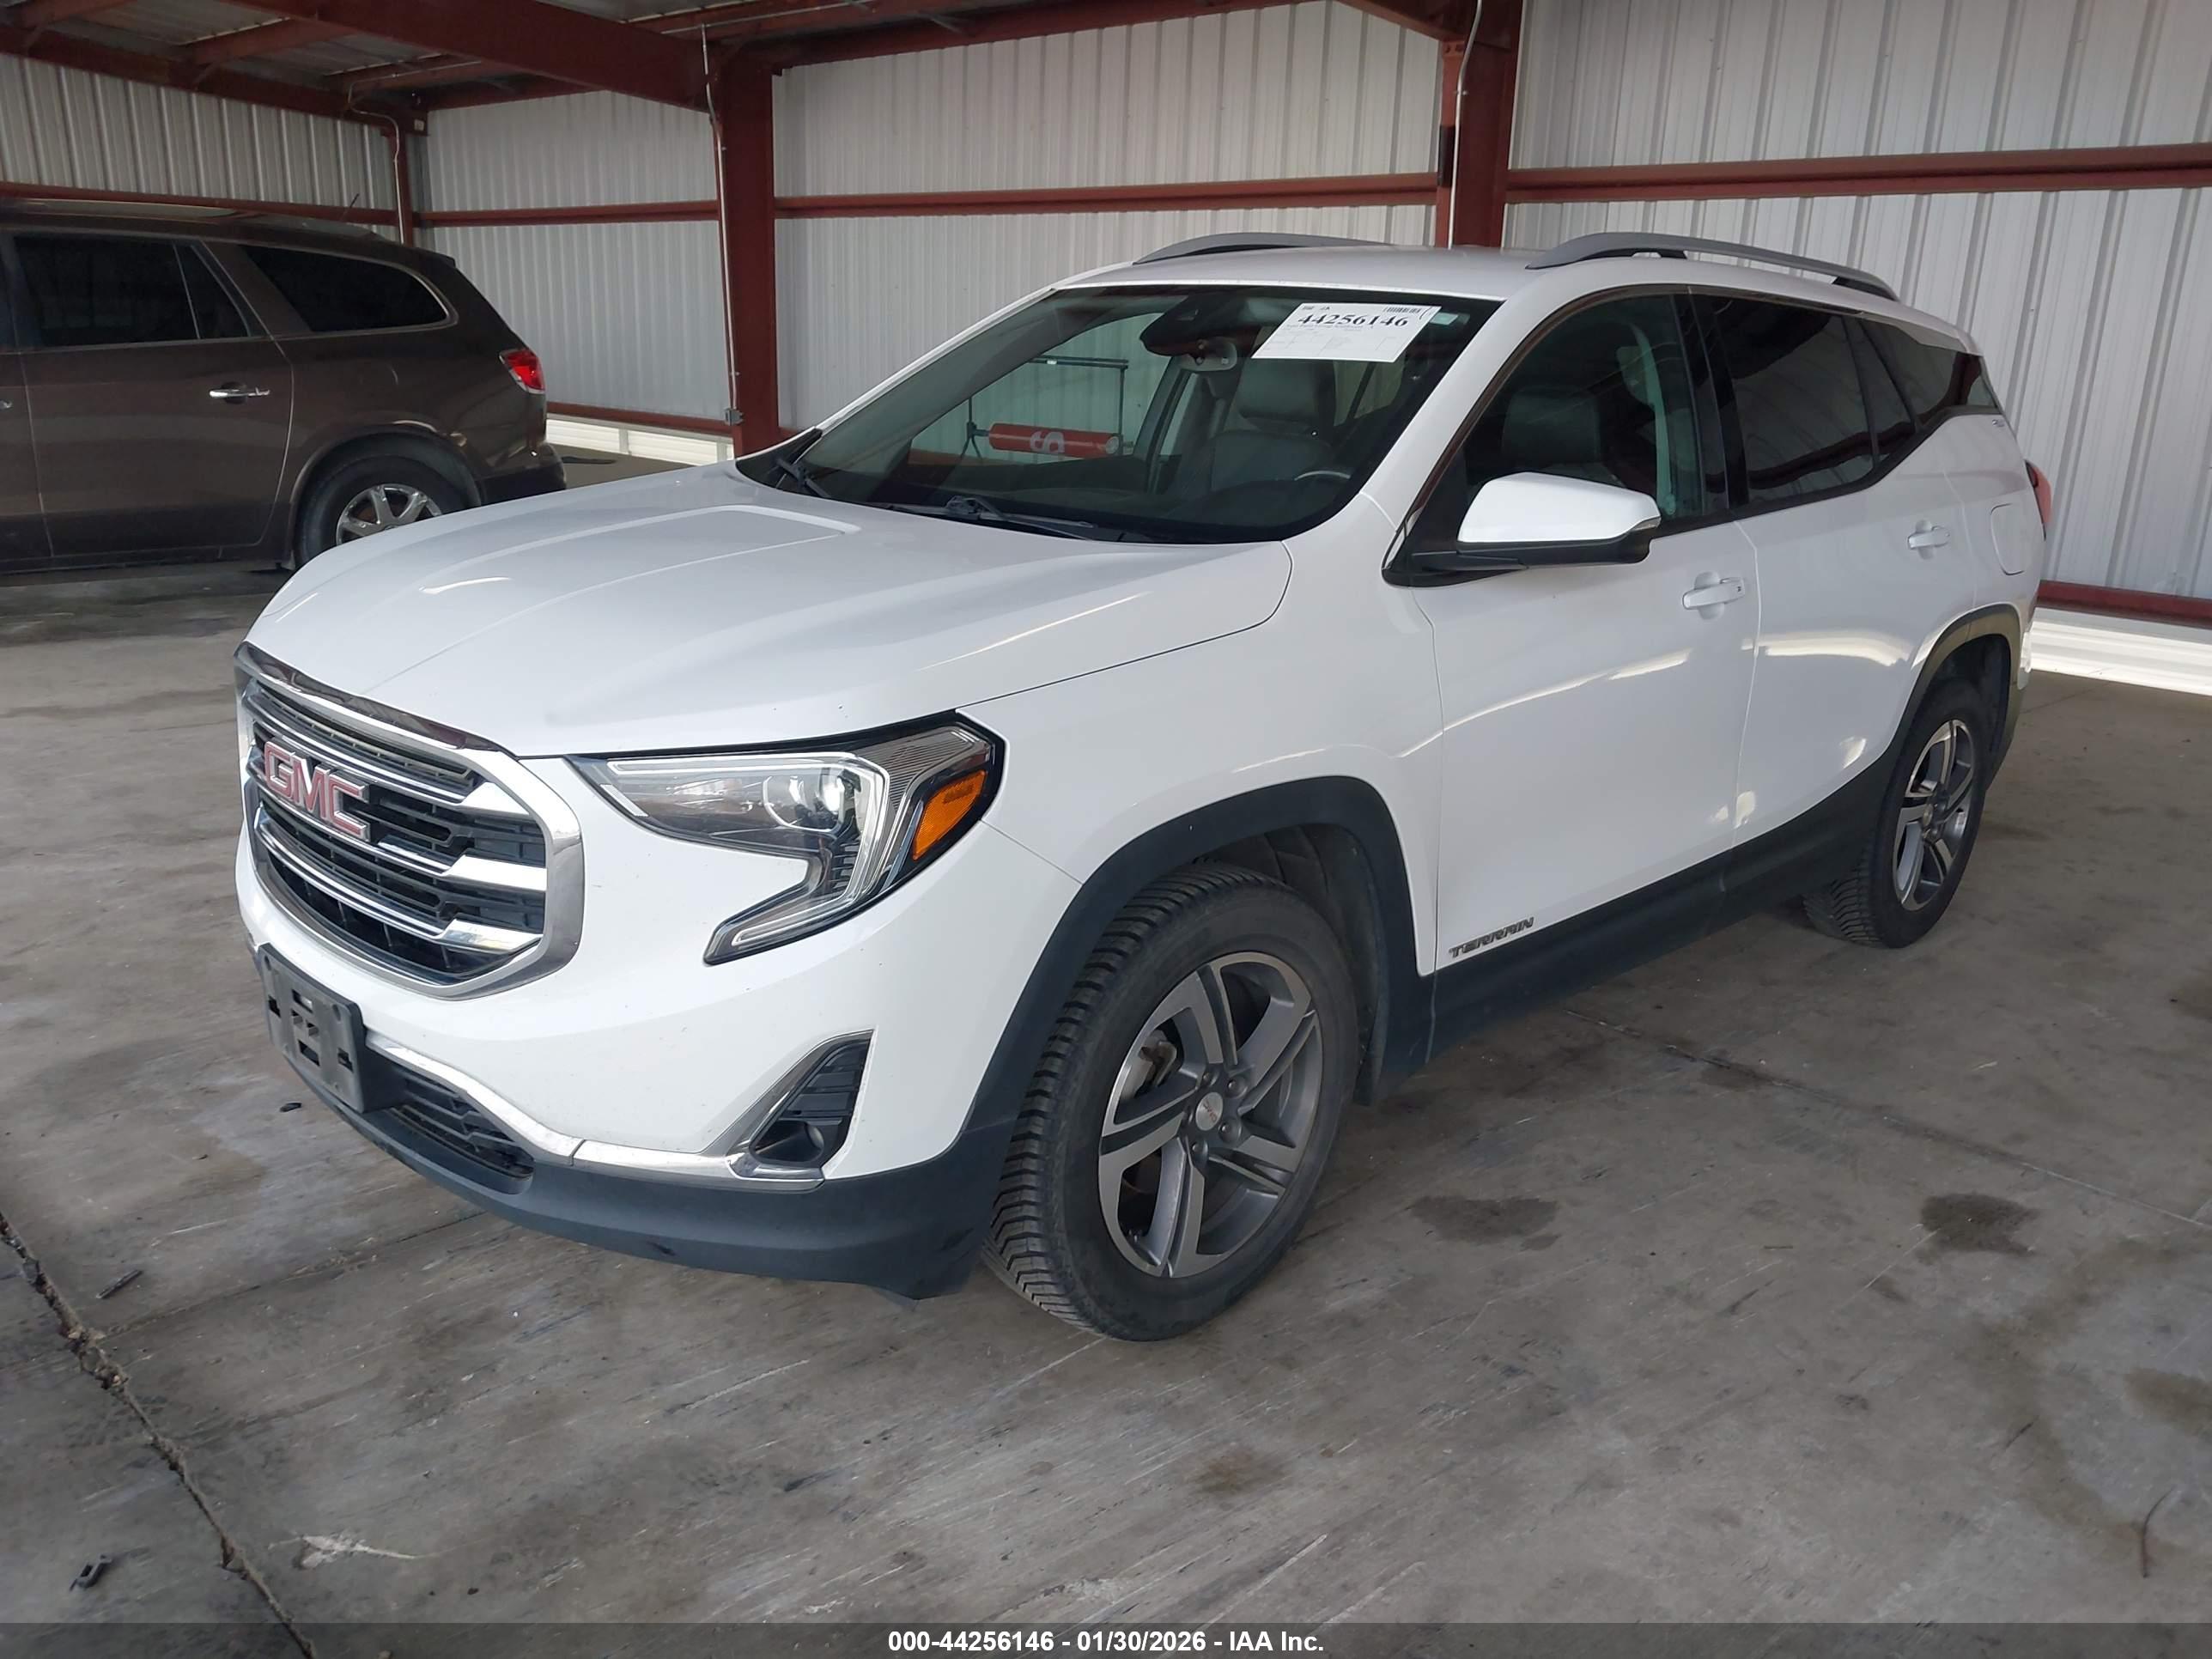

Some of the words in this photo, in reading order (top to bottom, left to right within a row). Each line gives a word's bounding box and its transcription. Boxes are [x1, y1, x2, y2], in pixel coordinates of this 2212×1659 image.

[1298, 313, 1408, 327] 44256146
[264, 741, 370, 842] GMC
[1449, 917, 1535, 958] TERRAIN
